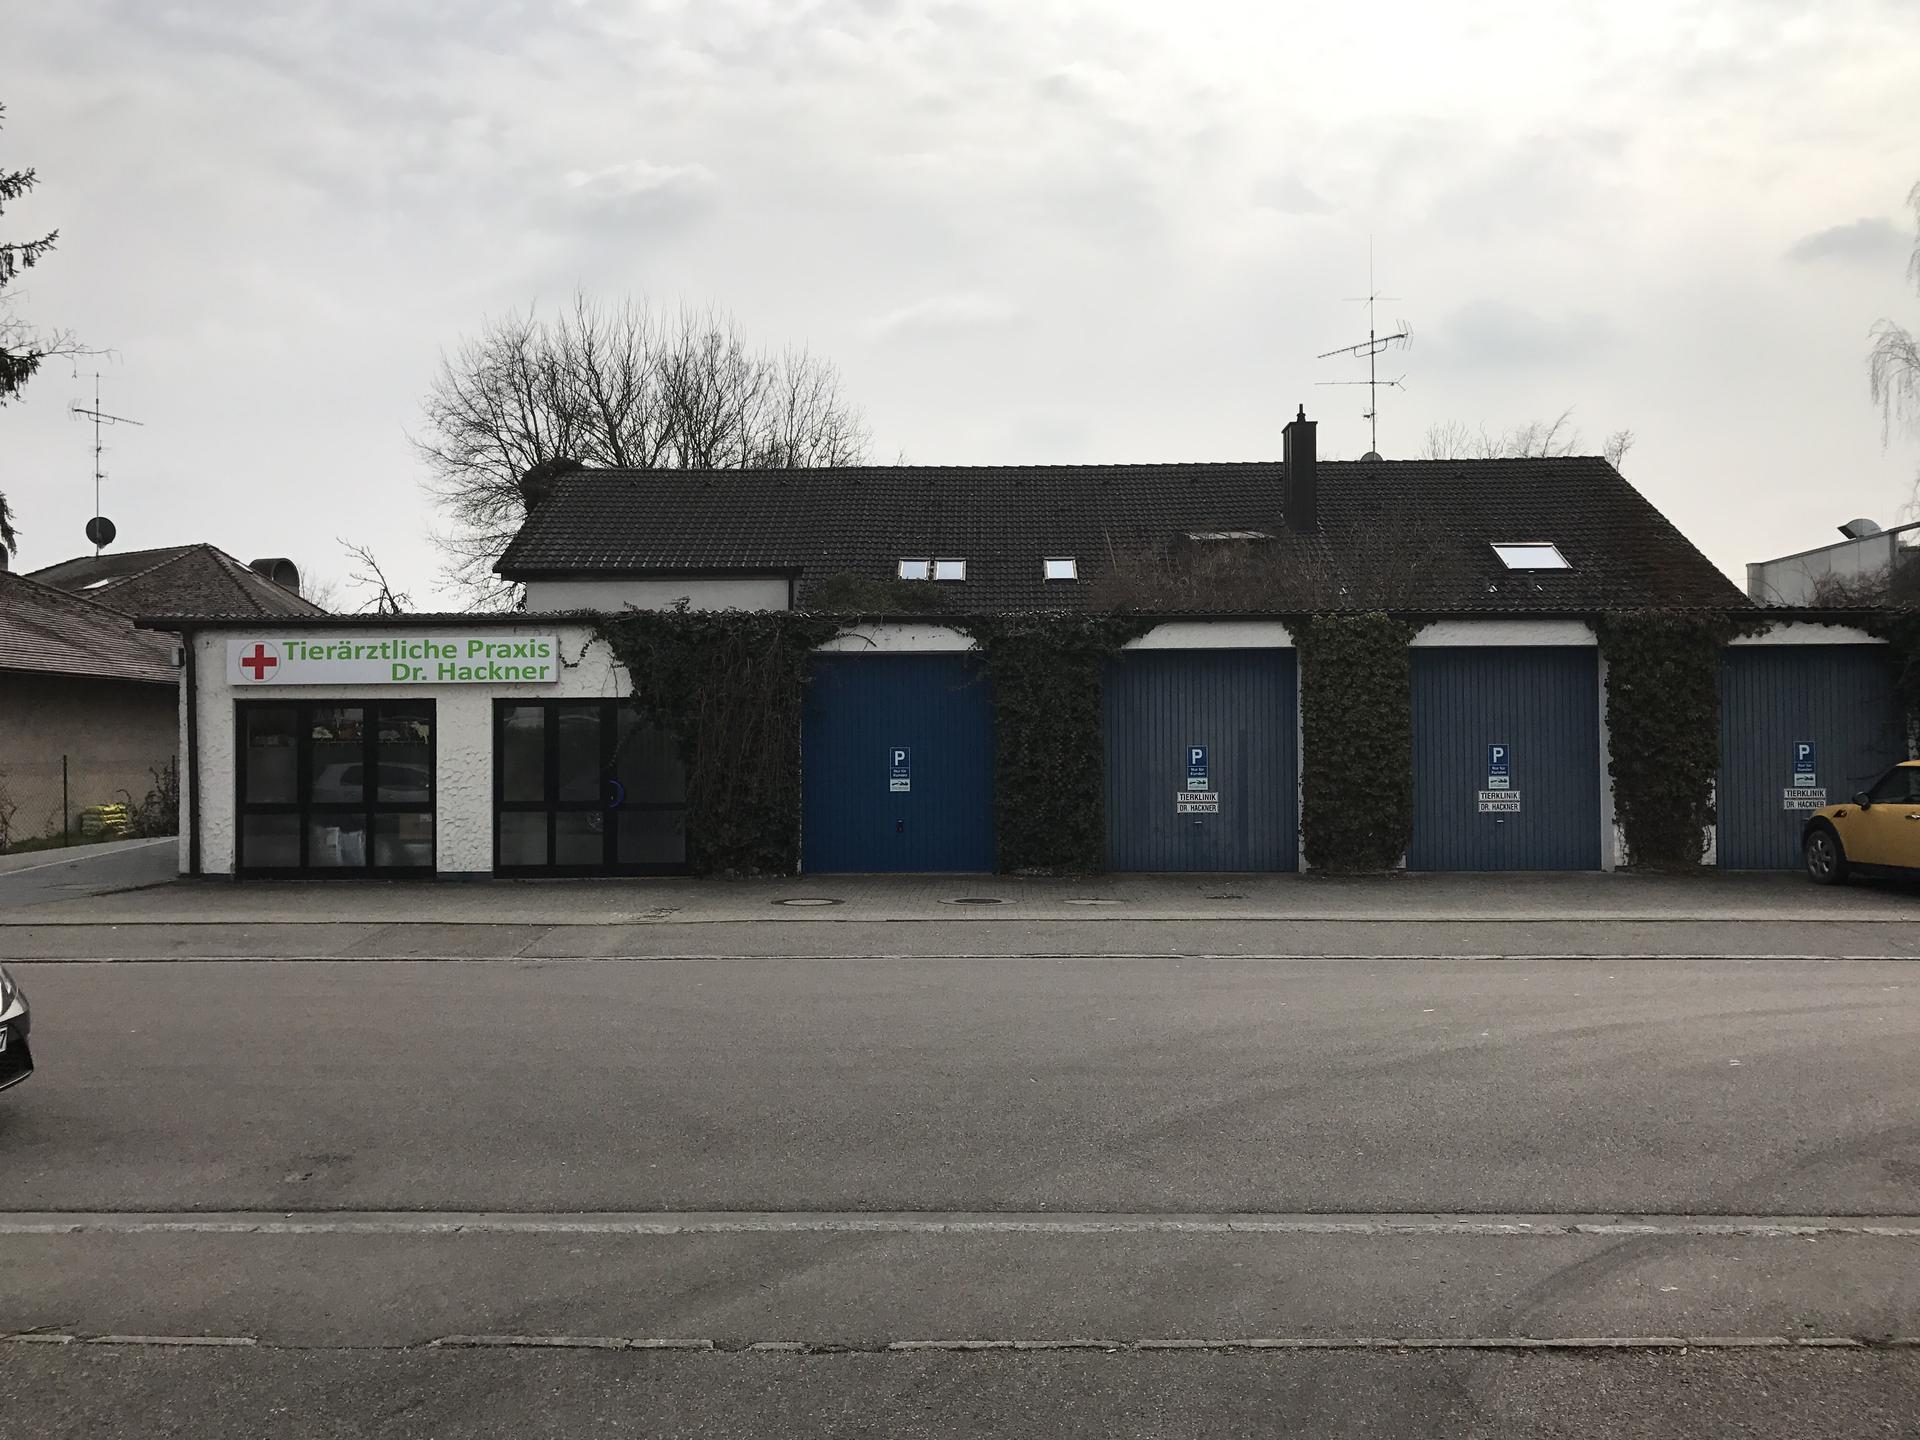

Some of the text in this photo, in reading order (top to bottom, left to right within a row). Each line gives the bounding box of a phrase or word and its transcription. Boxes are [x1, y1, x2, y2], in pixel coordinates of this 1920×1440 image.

[282, 638, 551, 660] Tierärztliche Praxis
[391, 661, 550, 681] Dr. Hackner
[894, 750, 905, 766] P
[1192, 749, 1203, 765] P
[1493, 747, 1504, 763] P
[1799, 744, 1810, 760] P
[1179, 793, 1217, 801] TIERKLINIK
[1480, 792, 1518, 800] TIERKLINIK
[1190, 804, 1217, 812] HACKNER
[1491, 803, 1518, 811] HACKNER
